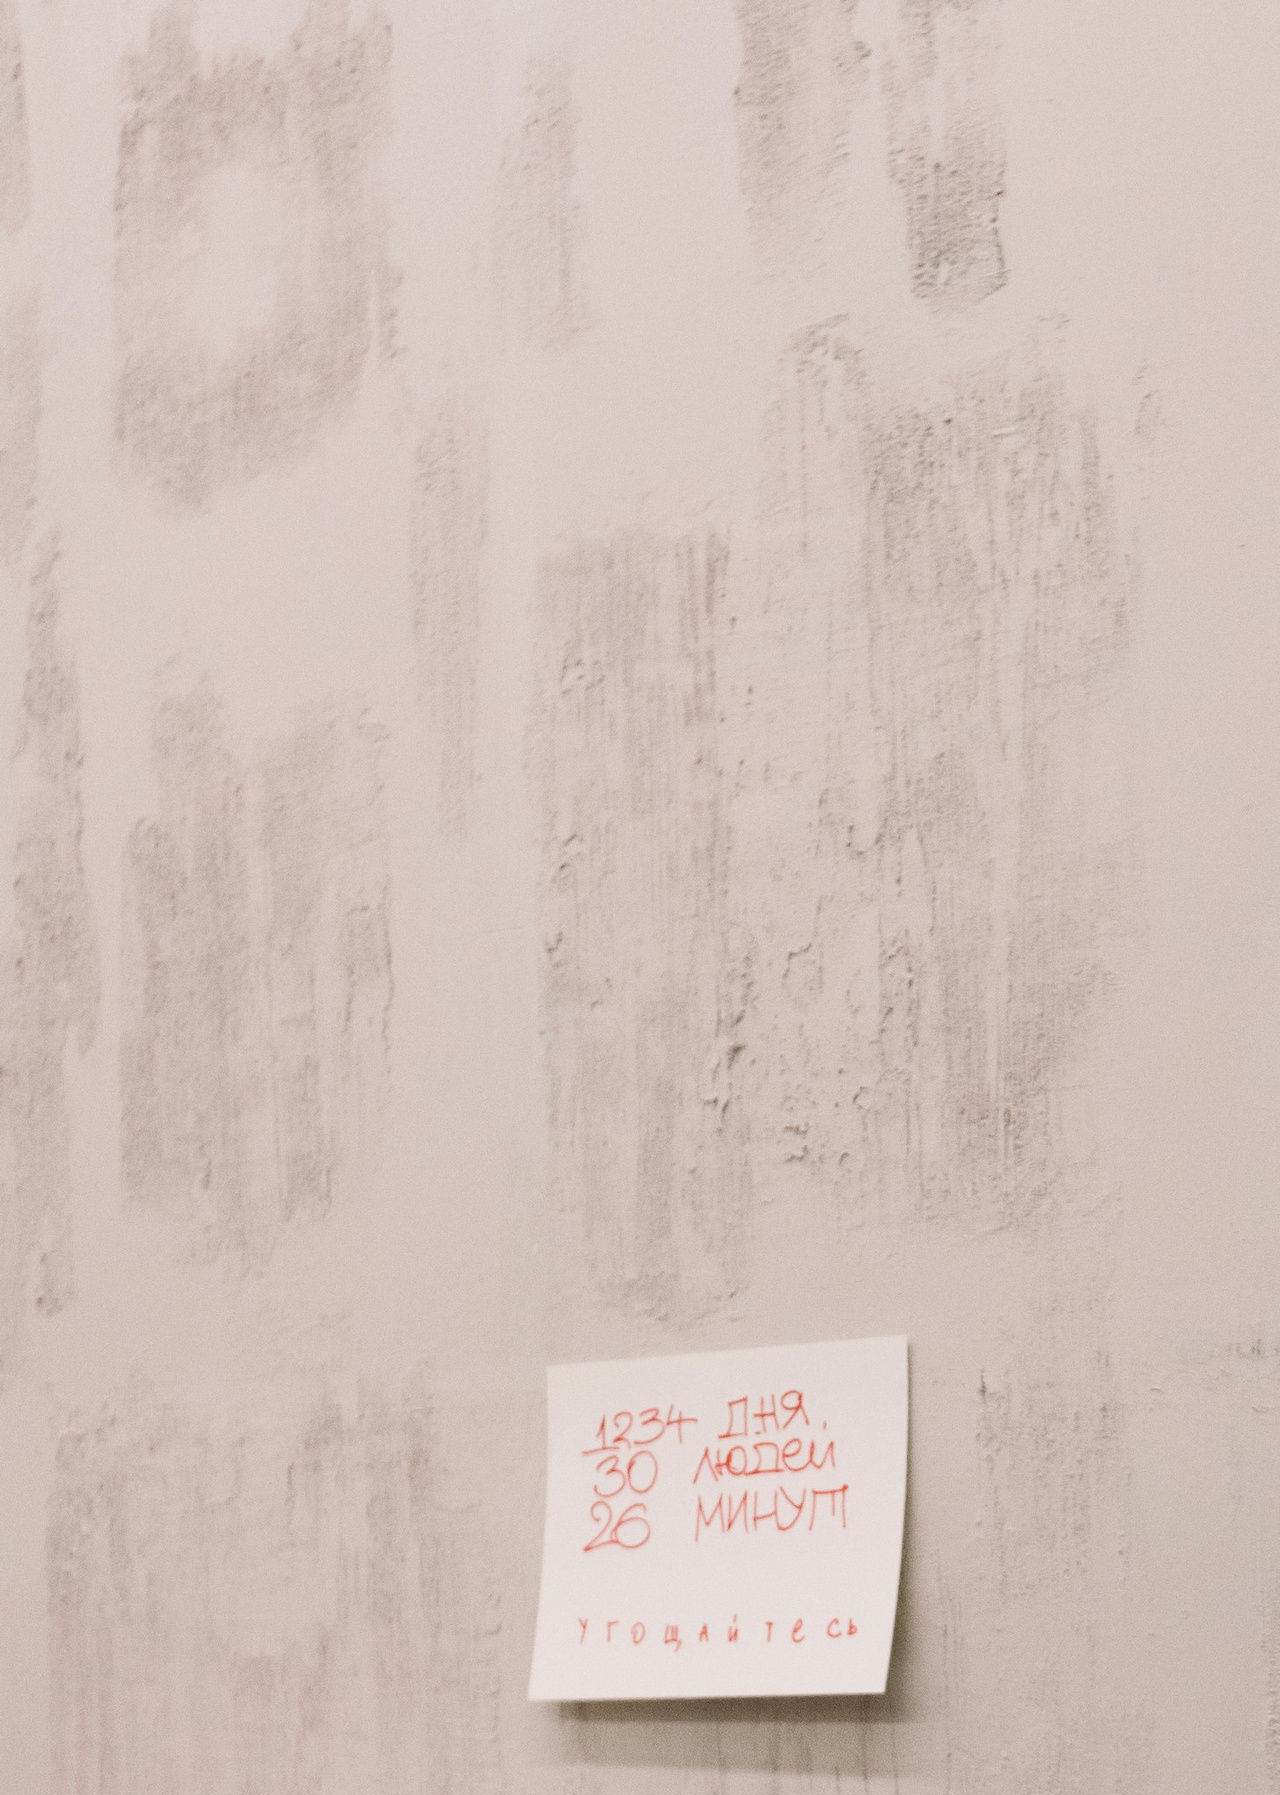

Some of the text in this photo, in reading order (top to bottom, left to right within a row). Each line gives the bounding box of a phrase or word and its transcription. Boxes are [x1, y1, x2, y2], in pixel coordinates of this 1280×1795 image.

[582, 1403, 698, 1455] 1234
[593, 1450, 659, 1498] 30
[582, 1483, 849, 1552] 26 МИНУТ
